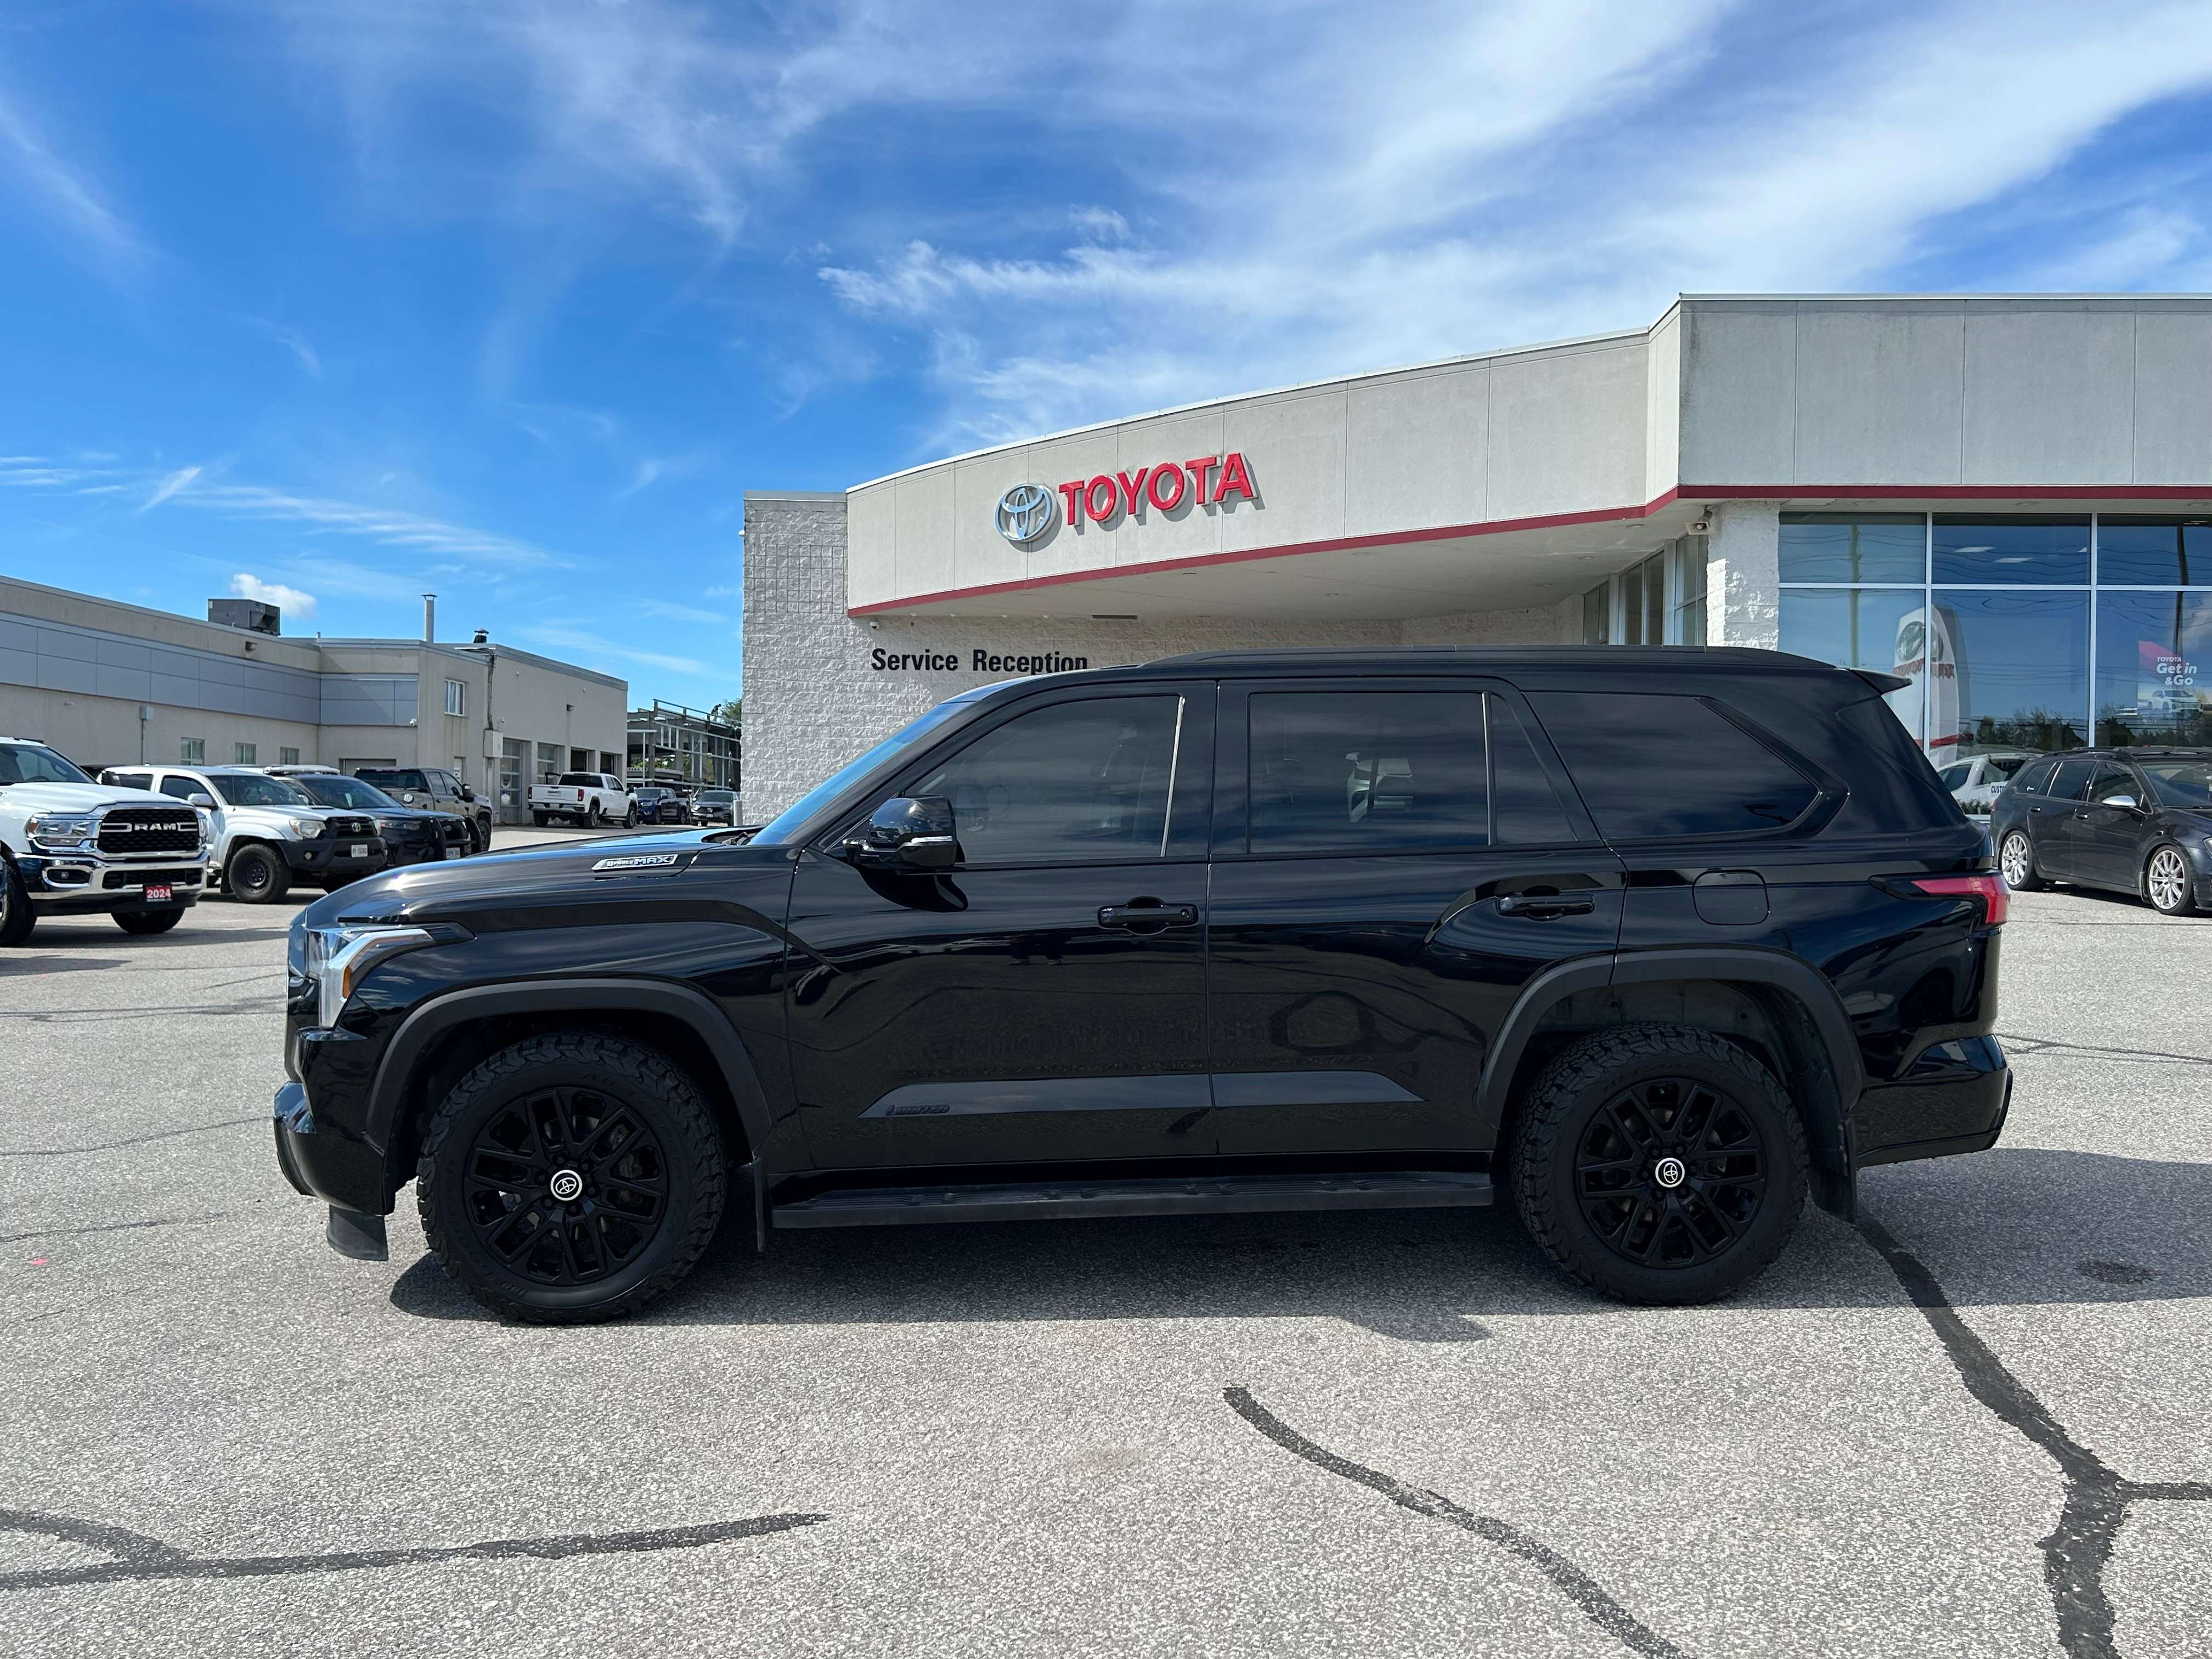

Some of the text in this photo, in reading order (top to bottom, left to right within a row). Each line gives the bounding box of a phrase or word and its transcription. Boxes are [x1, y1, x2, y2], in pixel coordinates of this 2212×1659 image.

[1058, 452, 1255, 526] TOYOTA
[872, 648, 1087, 675] Service Reception
[2157, 662, 2197, 674] Get in
[1991, 785, 2005, 794] CUST
[634, 857, 670, 865] MAX
[147, 888, 171, 898] 2024
